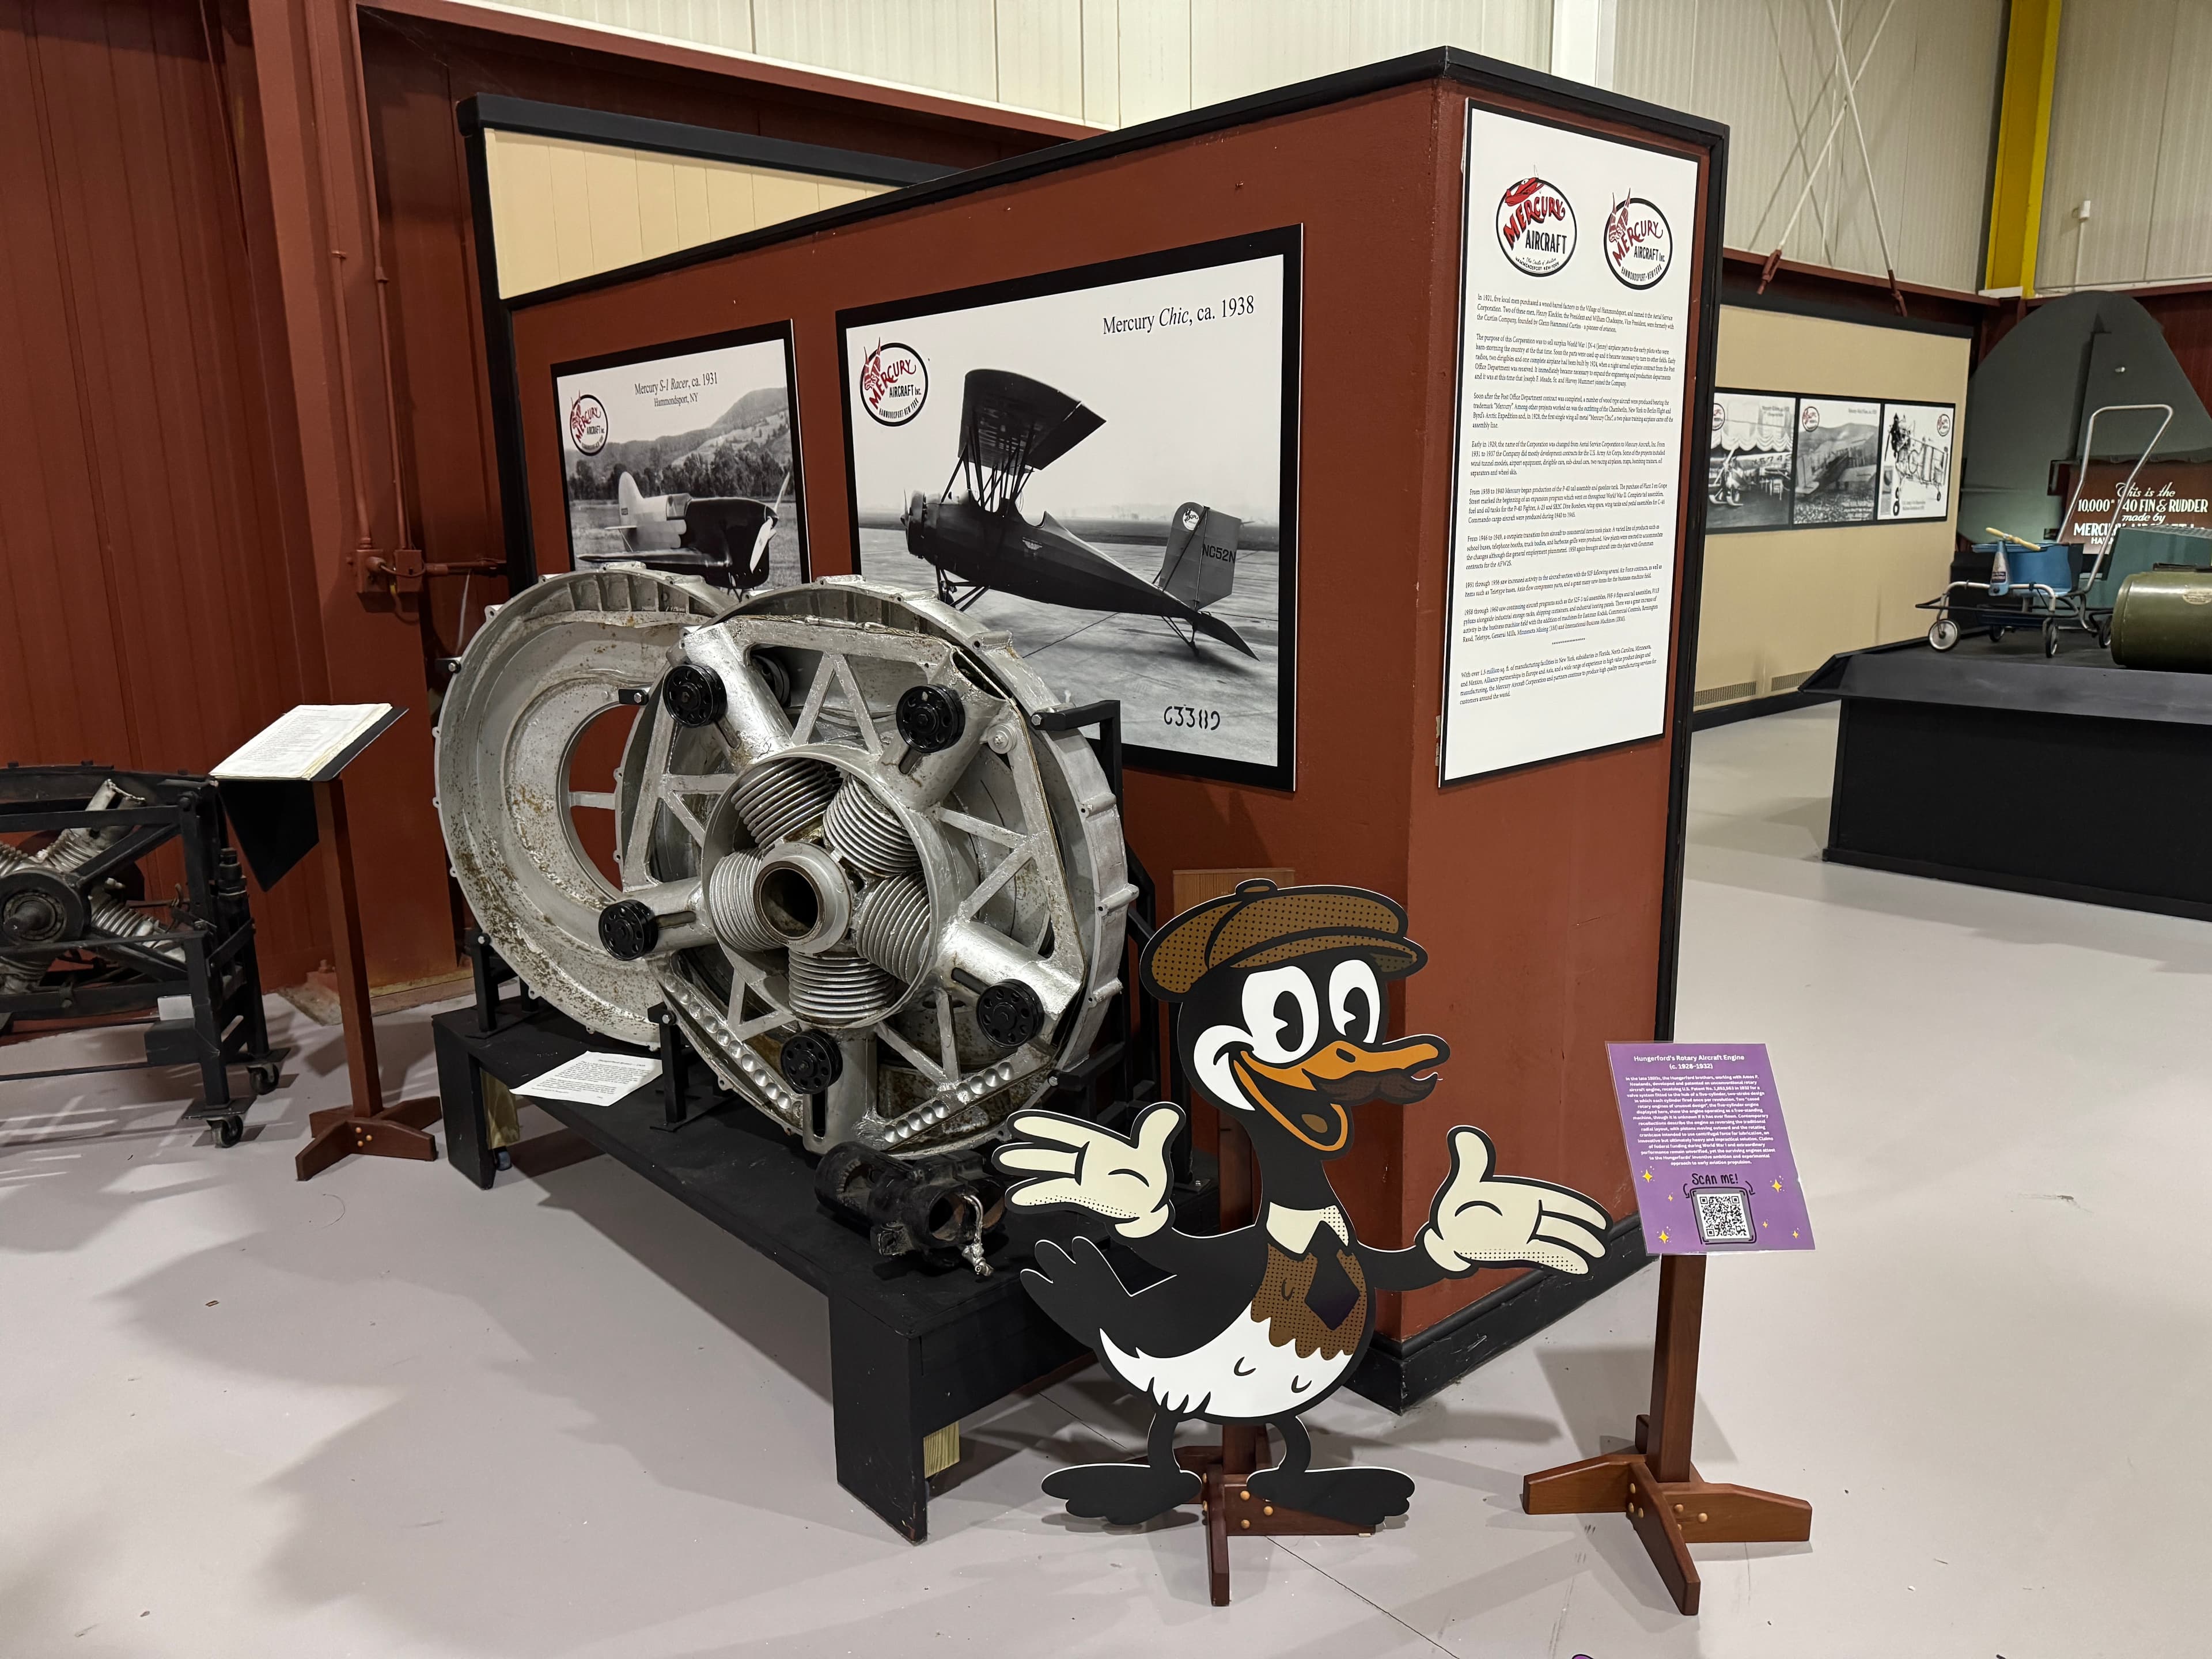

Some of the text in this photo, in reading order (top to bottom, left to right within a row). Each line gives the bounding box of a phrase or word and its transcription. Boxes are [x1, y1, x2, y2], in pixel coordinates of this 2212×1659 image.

[1503, 196, 1566, 251] MERCURY
[1525, 230, 1567, 254] AIRCRAFT
[1612, 220, 1663, 267] MERCURY
[1634, 246, 1659, 261] AIRCRAFT
[1501, 295, 1510, 303] local
[1103, 295, 1254, 335] Mercury Chic, ca. 1938
[635, 372, 717, 395] Mercury S-1 Racer, ca. 1931
[869, 359, 916, 410] MERCURY
[889, 385, 914, 398] AIRCRAFT
[654, 393, 699, 407] Hammondsport, NY
[575, 407, 601, 443] MERCURY
[2116, 482, 2175, 497] This is the
[2139, 499, 2155, 512] FIN
[2156, 499, 2168, 512] &
[2169, 499, 2208, 513] RUDDER
[2122, 513, 2166, 524] made by
[1202, 544, 1236, 563] NC52N
[1692, 1173, 1738, 1185] SCAN ME!
